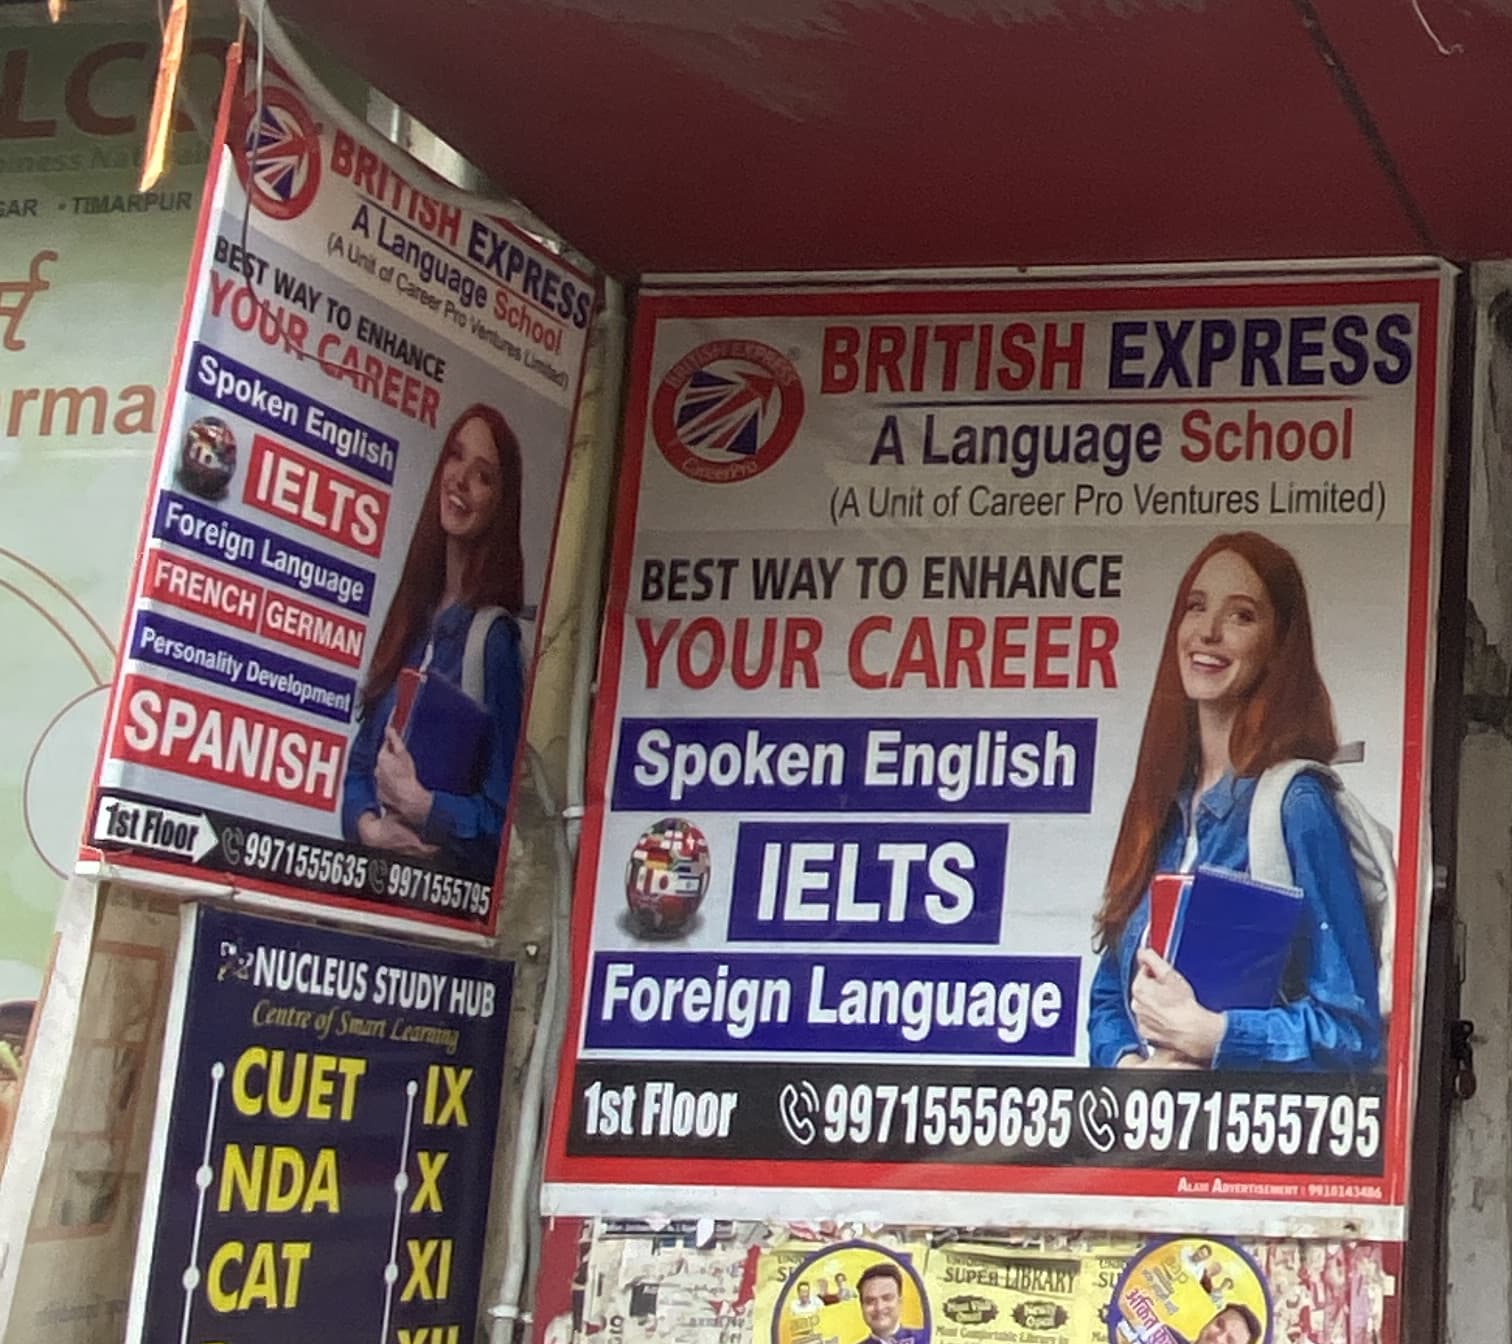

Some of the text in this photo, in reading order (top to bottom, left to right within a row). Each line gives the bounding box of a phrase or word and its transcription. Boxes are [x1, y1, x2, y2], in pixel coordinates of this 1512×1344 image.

[73, 192, 192, 214] TIMARPUR
[331, 130, 591, 329] BRITISH EXPRESS
[215, 236, 446, 384] BEST WAY TO ENHANCE
[348, 242, 375, 272] Unit
[378, 262, 394, 283] of
[396, 274, 442, 314] Career
[444, 302, 468, 328] Pro
[470, 314, 523, 360] Ventures
[523, 346, 570, 392] Limited)
[352, 205, 562, 355] A Language School
[210, 269, 442, 429] YOUR CAREER
[820, 312, 1414, 396] BRITISH EXPRESS
[0, 385, 156, 437] rma
[198, 355, 396, 472] Spoken English
[869, 406, 1355, 480] A Language School
[255, 449, 382, 546] IELTS
[829, 480, 1387, 526] (A Unit of Career Pro Ventures Limited)
[154, 560, 258, 620] FRENCH
[165, 502, 364, 603] Foreign Language
[641, 552, 1124, 603] BEST WAY TO ENHANCE
[265, 600, 364, 657] GERMAN
[633, 614, 1121, 691] YOUR CAREER
[141, 626, 352, 713] Personality Development
[124, 690, 341, 799] SPANISH
[633, 727, 1078, 803] Spoken English
[105, 803, 492, 916] 1st Floor 9971555635 9971555795
[756, 838, 978, 925] IELTS
[253, 946, 496, 1018] NUCLEUS STUDY HUB
[601, 961, 1063, 1044] Foreign Language
[252, 998, 460, 1054] Centre of Smart Learning
[232, 1045, 368, 1121] CUET
[422, 1064, 474, 1127] IX
[583, 1080, 1382, 1159] 1st Floor 9971555635 9971555795
[216, 1143, 341, 1214] NDA
[409, 1151, 449, 1214] X
[206, 1240, 312, 1314] CAT
[399, 1239, 454, 1302] XI
[944, 1266, 999, 1288] SUPER
[1005, 1264, 1076, 1294] LIBRARY
